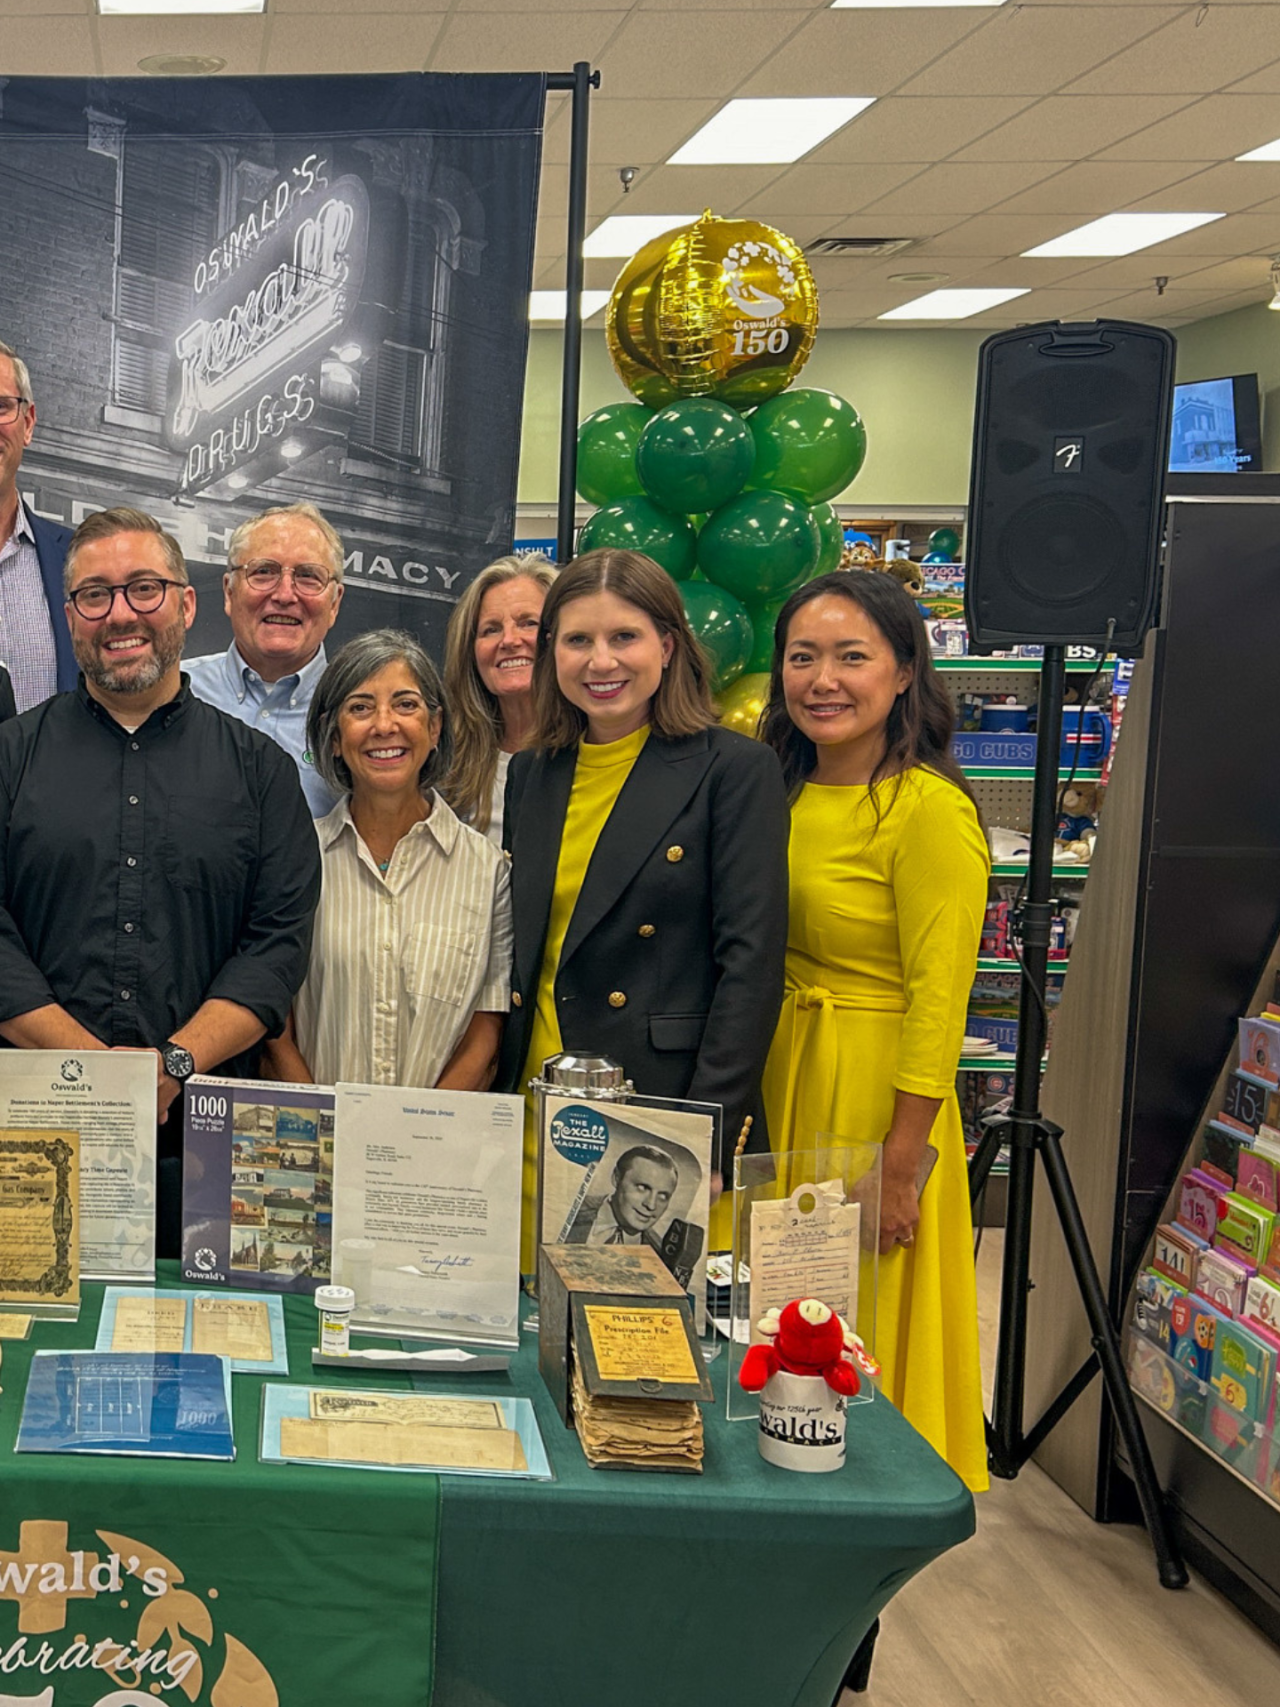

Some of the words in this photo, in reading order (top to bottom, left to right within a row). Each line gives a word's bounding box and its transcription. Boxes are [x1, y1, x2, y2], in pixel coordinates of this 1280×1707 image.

[733, 316, 787, 331] Oswald's
[730, 328, 790, 356] 150
[186, 374, 315, 482] DRUGS
[979, 742, 1034, 761] CUBS
[51, 1082, 93, 1092] Oswald's
[189, 1094, 228, 1118] 1000
[1233, 1080, 1258, 1123] 15
[191, 1116, 206, 1124] Piece
[206, 1117, 225, 1126] Puzzle
[569, 1118, 588, 1127] THE
[552, 1120, 606, 1140] Rexall
[552, 1139, 606, 1153] MAGAZINE
[2, 1183, 15, 1194] Gas
[15, 1184, 46, 1196] Company
[184, 1269, 226, 1282] Oswald's
[661, 1315, 674, 1327] 6
[604, 1324, 652, 1334] Prescription
[654, 1326, 670, 1335] File
